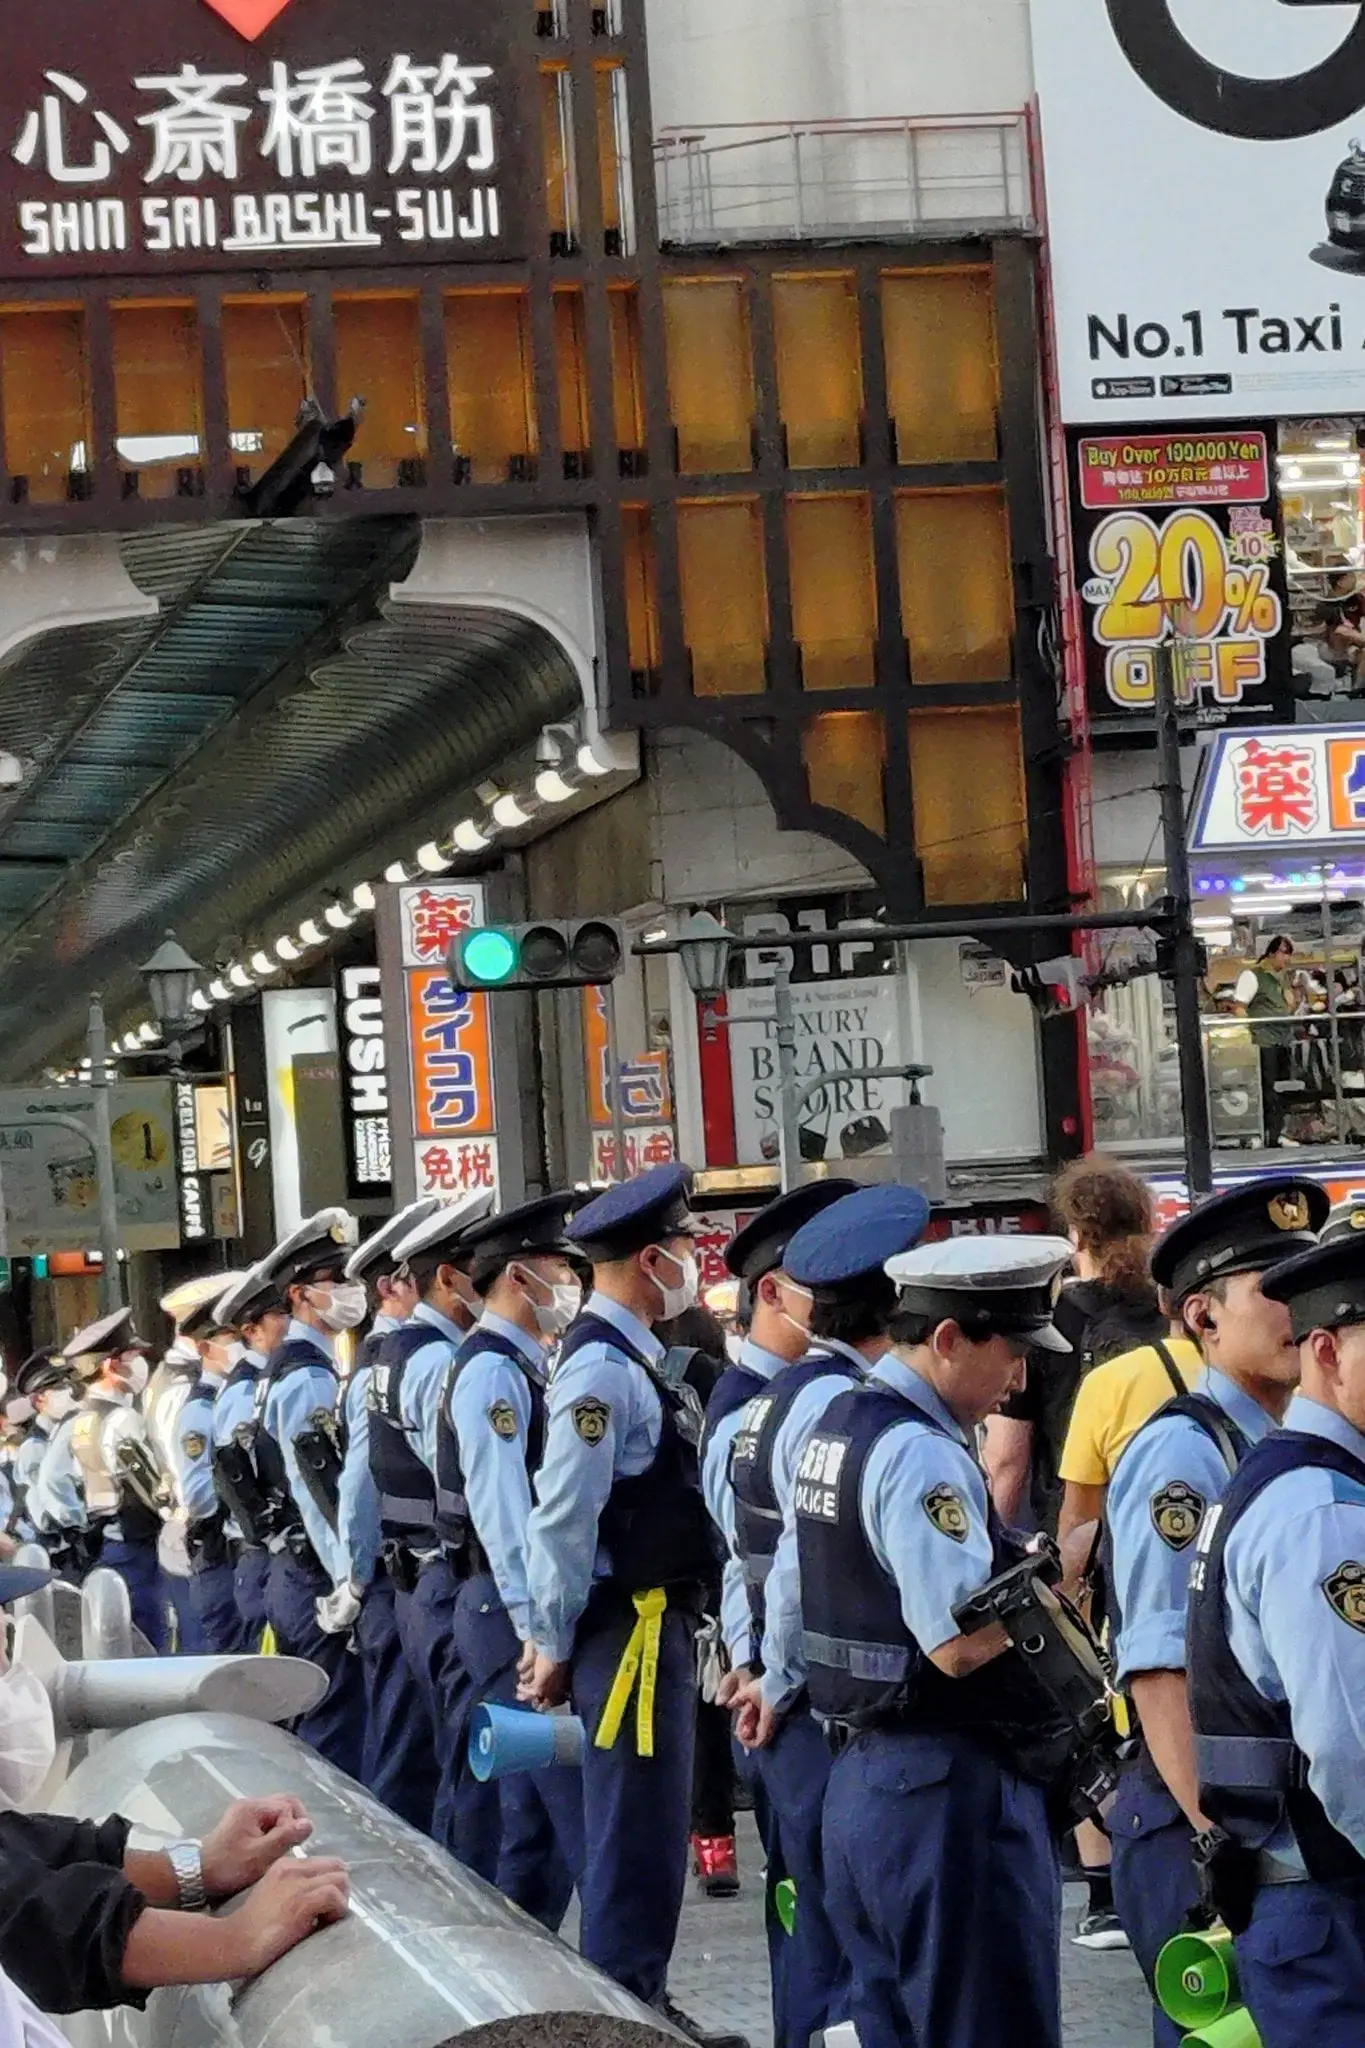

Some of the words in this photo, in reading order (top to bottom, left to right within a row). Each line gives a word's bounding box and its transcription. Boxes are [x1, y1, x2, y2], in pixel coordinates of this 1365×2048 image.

[11, 54, 496, 183] 心斎橋筋
[20, 199, 127, 254] SHIN
[141, 196, 217, 249] SAI
[1088, 310, 1203, 360] No.1
[1222, 303, 1342, 354] Taxi
[1087, 446, 1117, 467] Buy
[1122, 444, 1161, 464] Over
[1227, 439, 1259, 460] Yen
[1092, 512, 1279, 641] 20%
[1110, 640, 1262, 702] OFF
[1239, 738, 1314, 831] 薬
[343, 967, 388, 1112] LUSH
[764, 1006, 868, 1040] LXURY
[754, 1077, 883, 1119] SORE
[420, 1143, 494, 1191] 免税
[796, 1484, 836, 1517] OLICE
